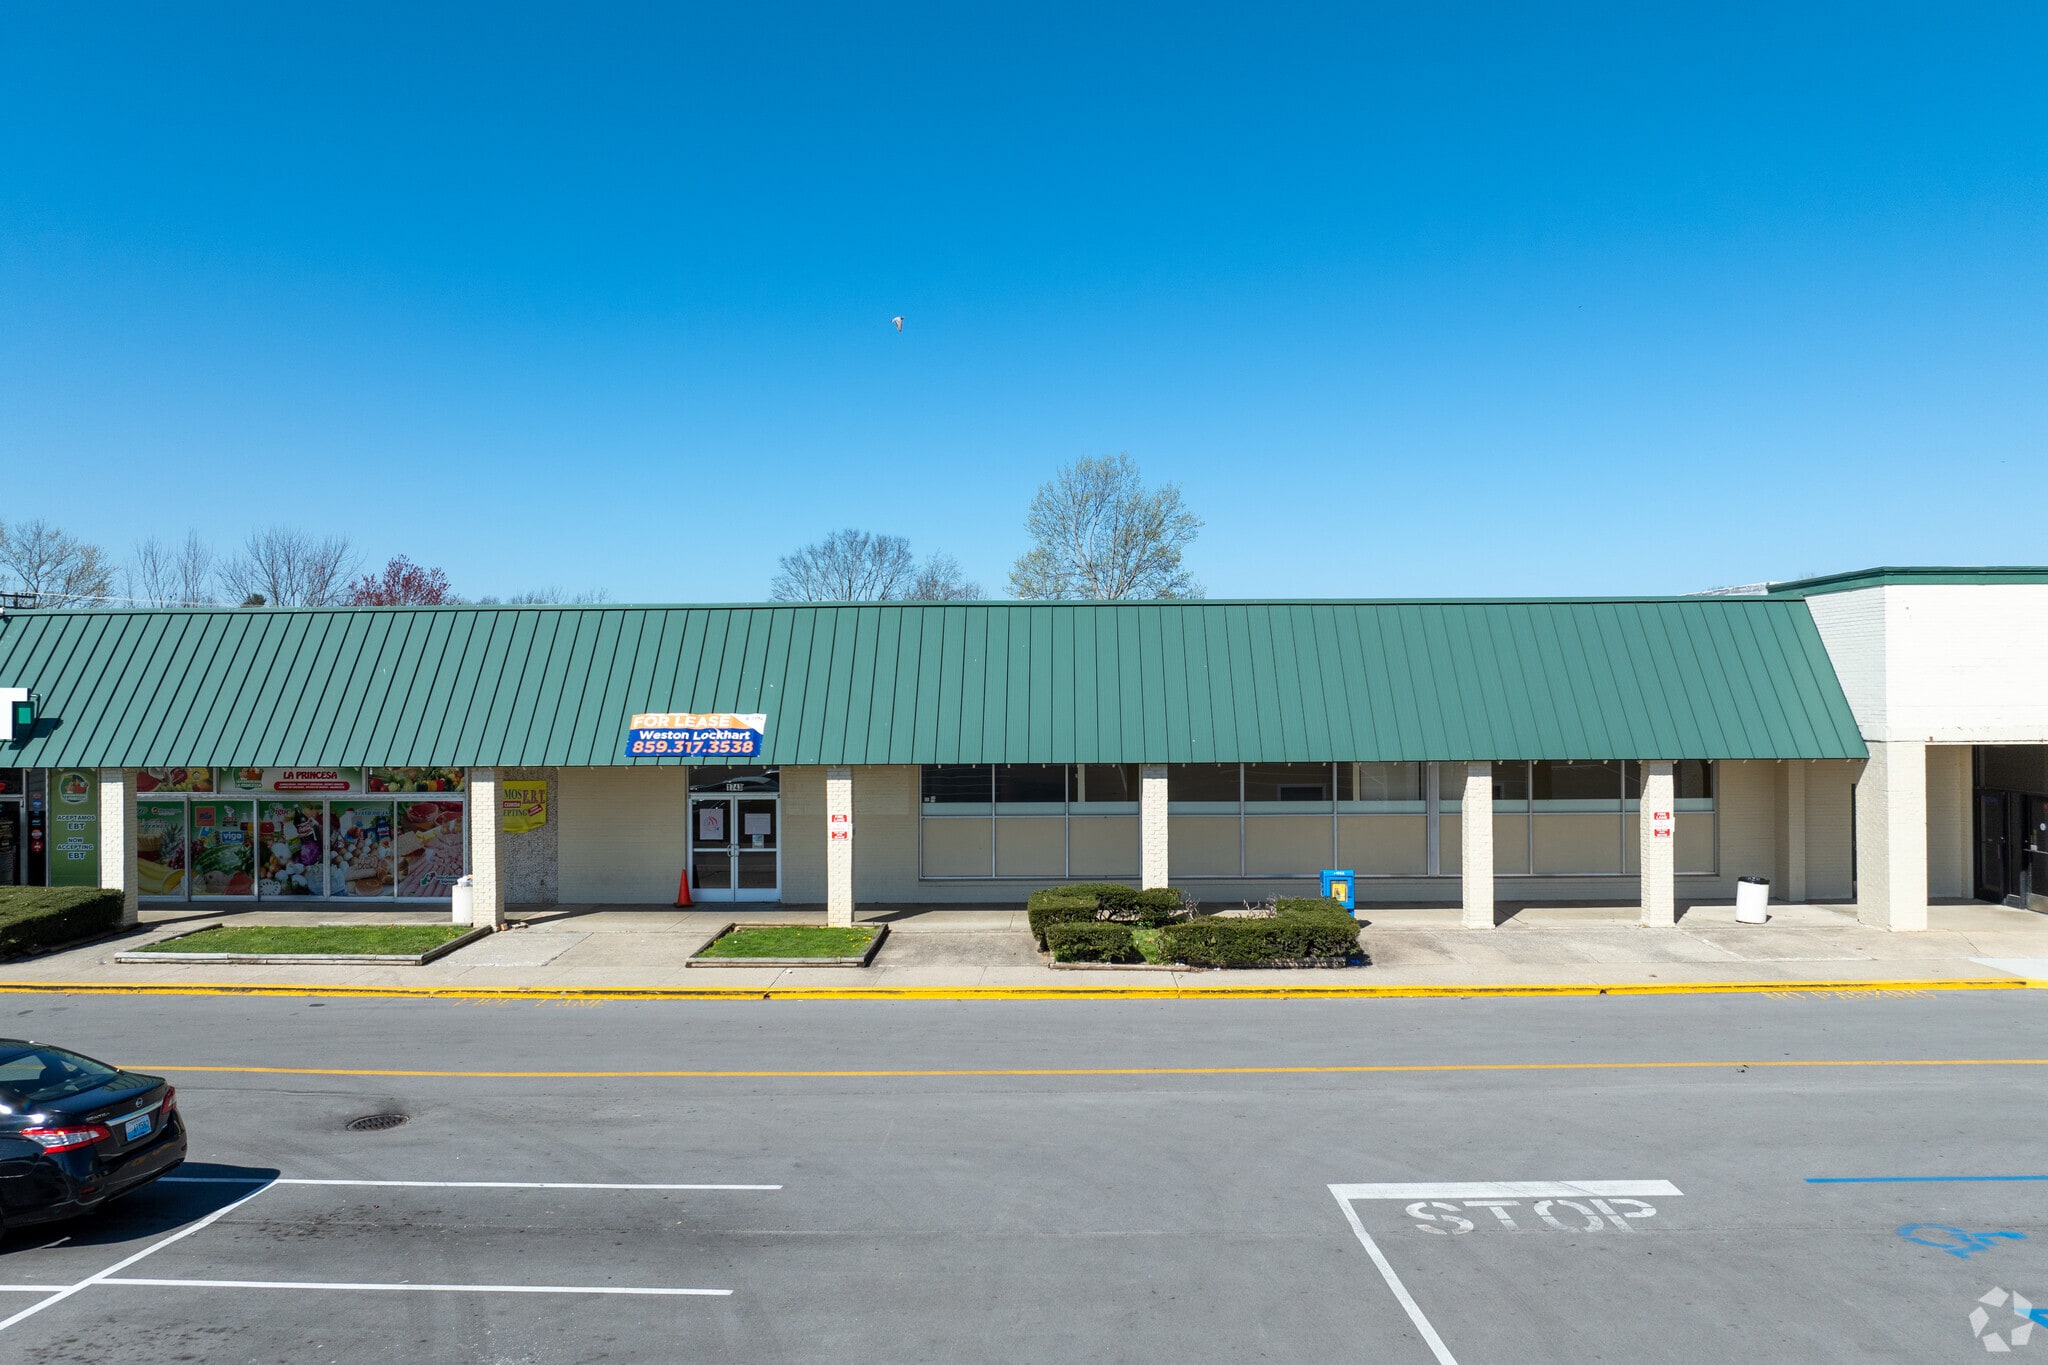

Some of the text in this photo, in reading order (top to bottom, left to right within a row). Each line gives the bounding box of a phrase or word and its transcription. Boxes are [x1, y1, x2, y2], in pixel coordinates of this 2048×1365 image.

[633, 715, 730, 727] FOR LEASE
[639, 730, 750, 740] Weston Lockhart
[632, 740, 754, 753] 859.317.3538
[283, 771, 338, 779] LA PRINCESA
[223, 831, 242, 841] vigo
[1405, 1199, 1657, 1235] STOP
